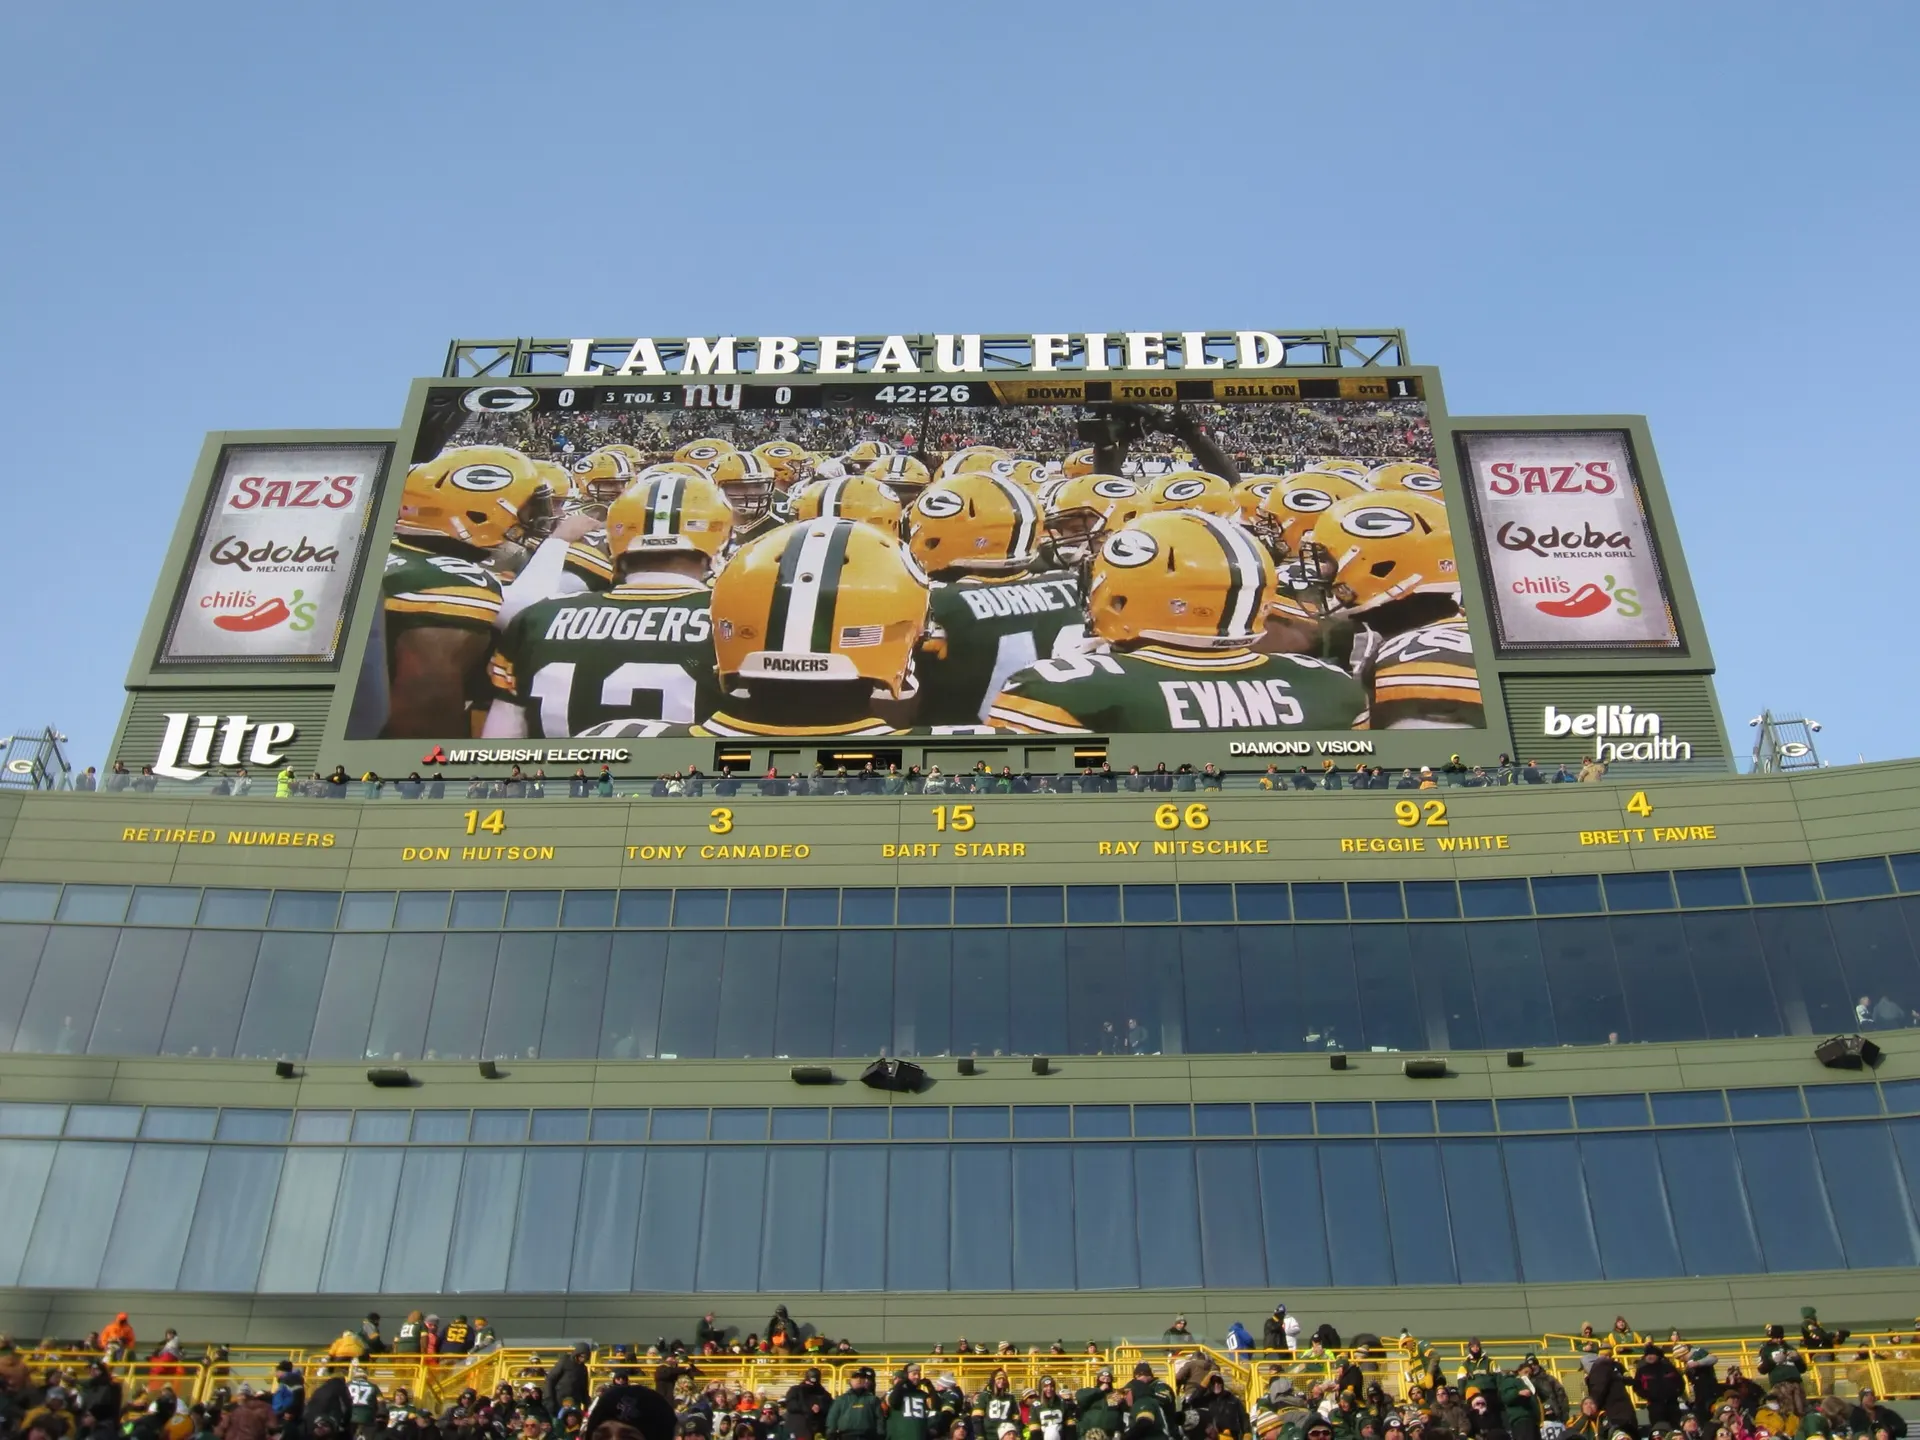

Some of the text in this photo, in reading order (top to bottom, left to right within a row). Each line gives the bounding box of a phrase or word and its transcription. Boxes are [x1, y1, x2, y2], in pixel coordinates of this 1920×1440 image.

[563, 331, 1285, 376] LAMBEAU FIELD
[558, 388, 575, 407] 0
[605, 391, 672, 403] 3 TOL 3
[775, 386, 792, 404] 0
[875, 385, 970, 403] 42:26
[1027, 387, 1082, 399] DOWN
[1120, 386, 1174, 398] TO GO
[1224, 384, 1296, 397] BALL ON
[1396, 381, 1408, 396] 1
[1489, 461, 1616, 496] SAZ'S
[229, 475, 357, 510] SAZ'S
[1497, 521, 1632, 557] Qdoba
[210, 535, 339, 572] Qdoba
[1604, 550, 1636, 558] GRILL
[1512, 576, 1570, 594] chili's
[200, 589, 256, 609] chili's
[545, 606, 710, 642] RODGERS
[763, 656, 829, 672] PACKERS
[1159, 679, 1304, 728] EVANS
[1545, 705, 1660, 736] bellin
[152, 713, 294, 781] Lite
[449, 748, 629, 762] MITSUBISHI ELECTRIC
[1230, 740, 1373, 754] DIAMOND VISION
[1596, 735, 1691, 761] health
[1394, 800, 1450, 828] 92
[1627, 791, 1653, 817] 4
[463, 809, 507, 835] 14
[708, 807, 734, 835] 3
[931, 805, 976, 832] 15
[1154, 803, 1210, 830] 66
[122, 827, 336, 848] RETIRED NUMBERS
[1340, 835, 1511, 852] REGGIE WHITE
[1579, 825, 1717, 846] BRETT FAVRE
[402, 846, 556, 861] DON HUTSON
[626, 844, 811, 860] TONY CANADEO
[882, 842, 1027, 858] BART STARR
[1099, 839, 1270, 856] RAY NITSCHKE
[400, 1324, 414, 1338] 21
[446, 1327, 468, 1343] 52
[903, 1396, 924, 1418] 15
[989, 1399, 1011, 1420] 87
